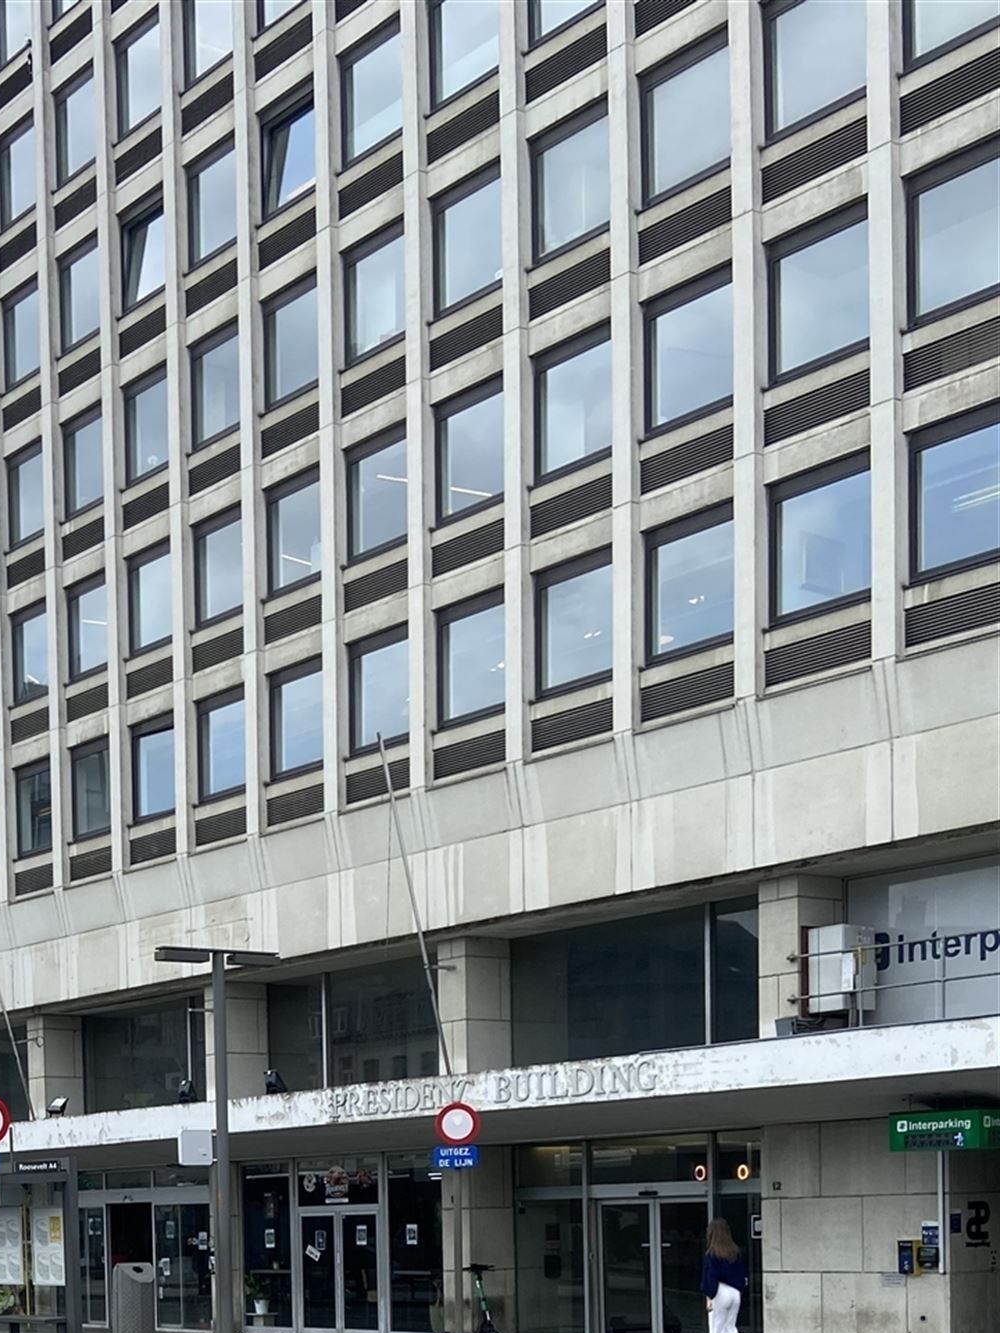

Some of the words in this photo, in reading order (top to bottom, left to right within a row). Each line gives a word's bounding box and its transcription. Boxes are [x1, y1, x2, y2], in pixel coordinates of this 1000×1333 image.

[331, 1080, 475, 1118] PRESIDENT
[493, 1060, 658, 1104] BUILDING
[908, 1118, 972, 1132] Interparking
[18, 1163, 47, 1171] Roosevelt
[438, 1160, 450, 1168] DE
[454, 1159, 474, 1168] LIJN
